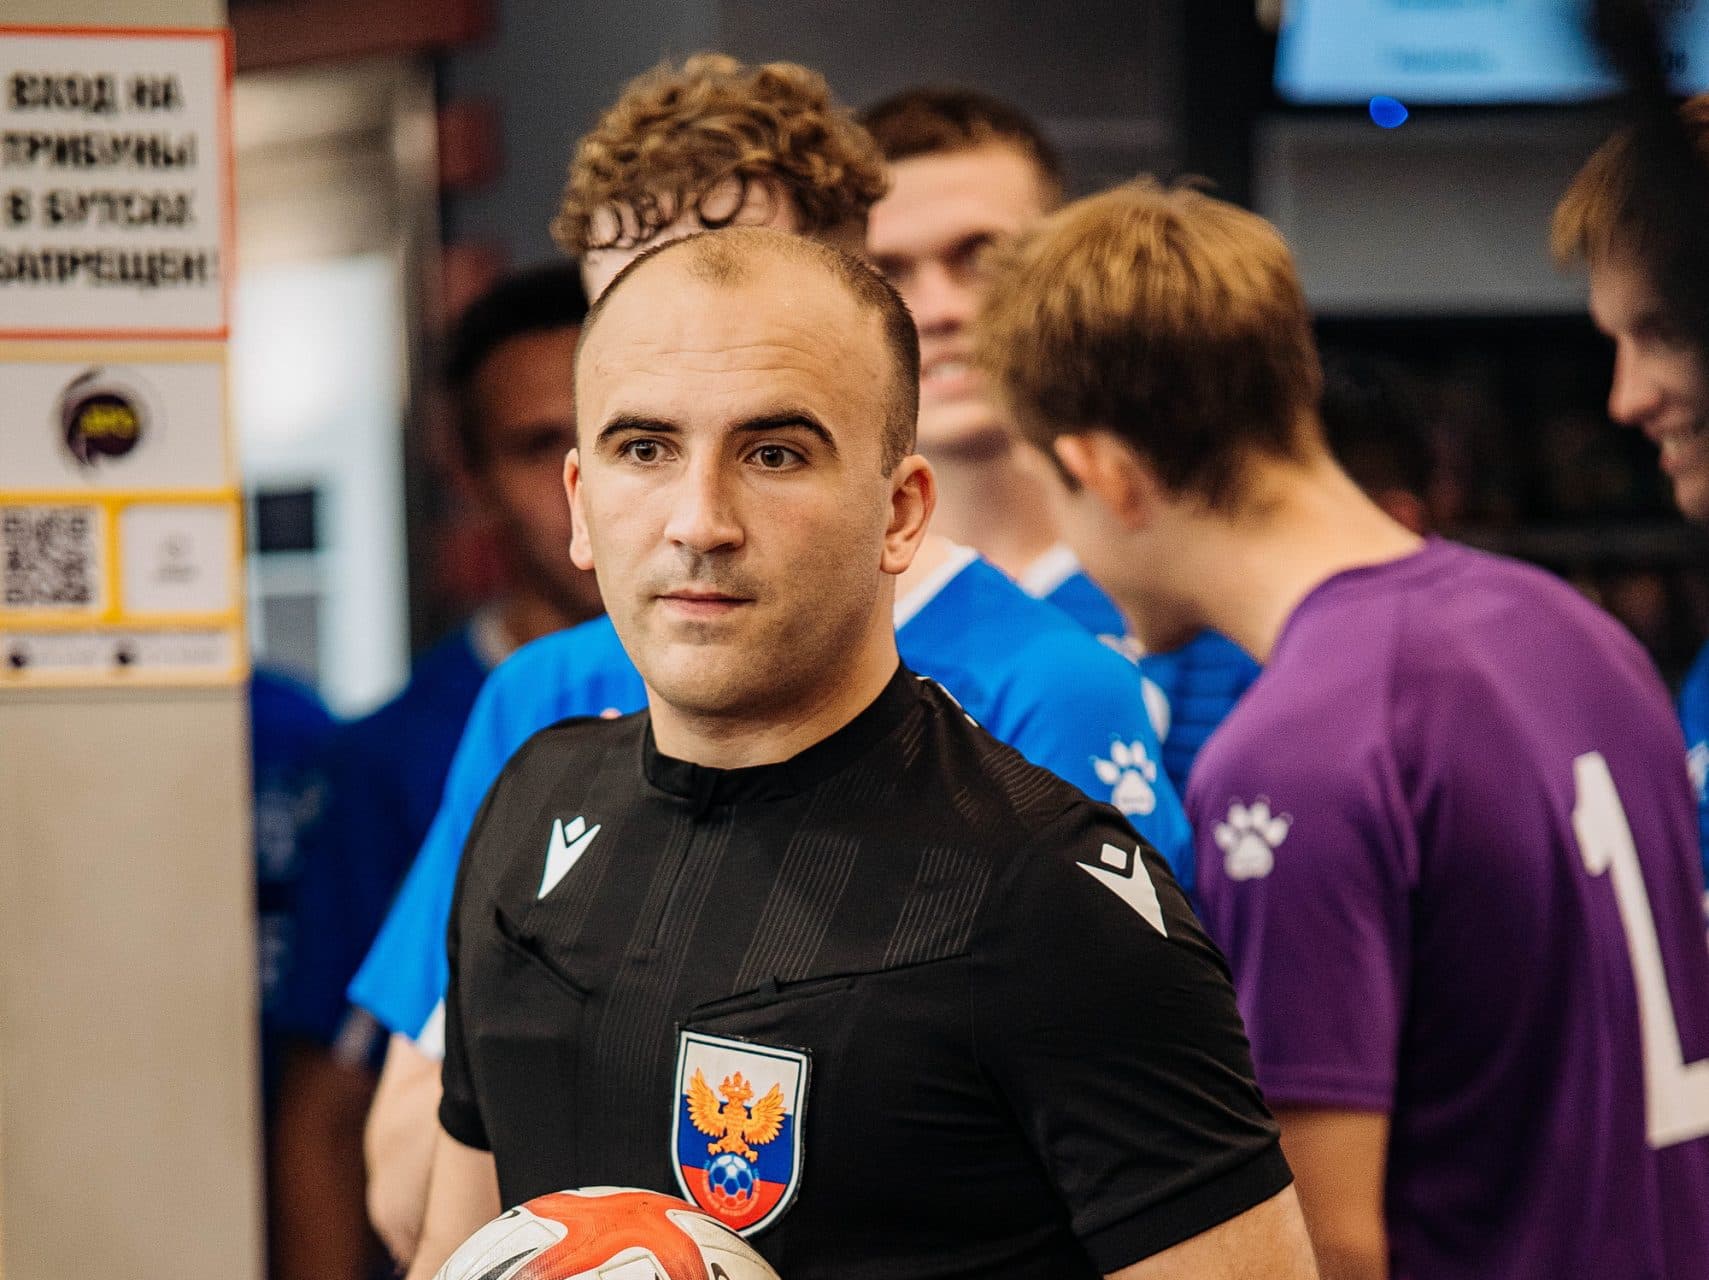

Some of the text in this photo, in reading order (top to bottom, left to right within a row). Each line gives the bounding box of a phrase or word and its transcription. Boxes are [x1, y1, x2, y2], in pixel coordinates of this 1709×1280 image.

[8, 71, 182, 114] ВХОД НА
[2, 131, 197, 167] ТРИБУНЫ
[8, 189, 195, 226] В БУТСАХ
